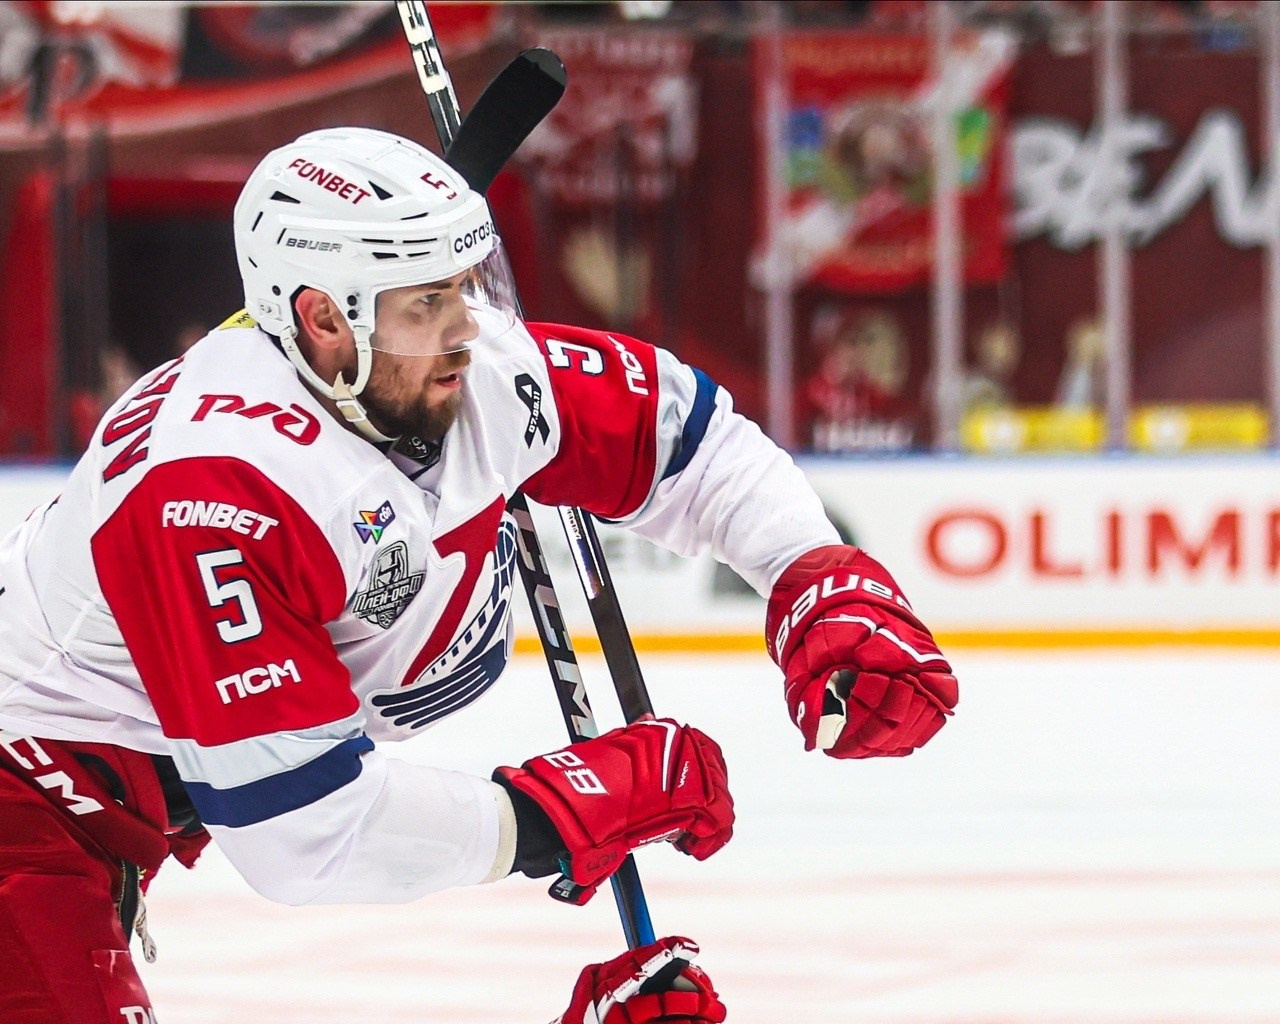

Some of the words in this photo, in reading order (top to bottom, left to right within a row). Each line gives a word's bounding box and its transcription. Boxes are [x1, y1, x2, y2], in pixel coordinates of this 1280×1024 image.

[287, 158, 372, 206] FONBET
[285, 237, 343, 253] BAUER
[162, 500, 279, 540] FONBET
[195, 548, 263, 643] 5
[215, 658, 302, 705] ПСМ
